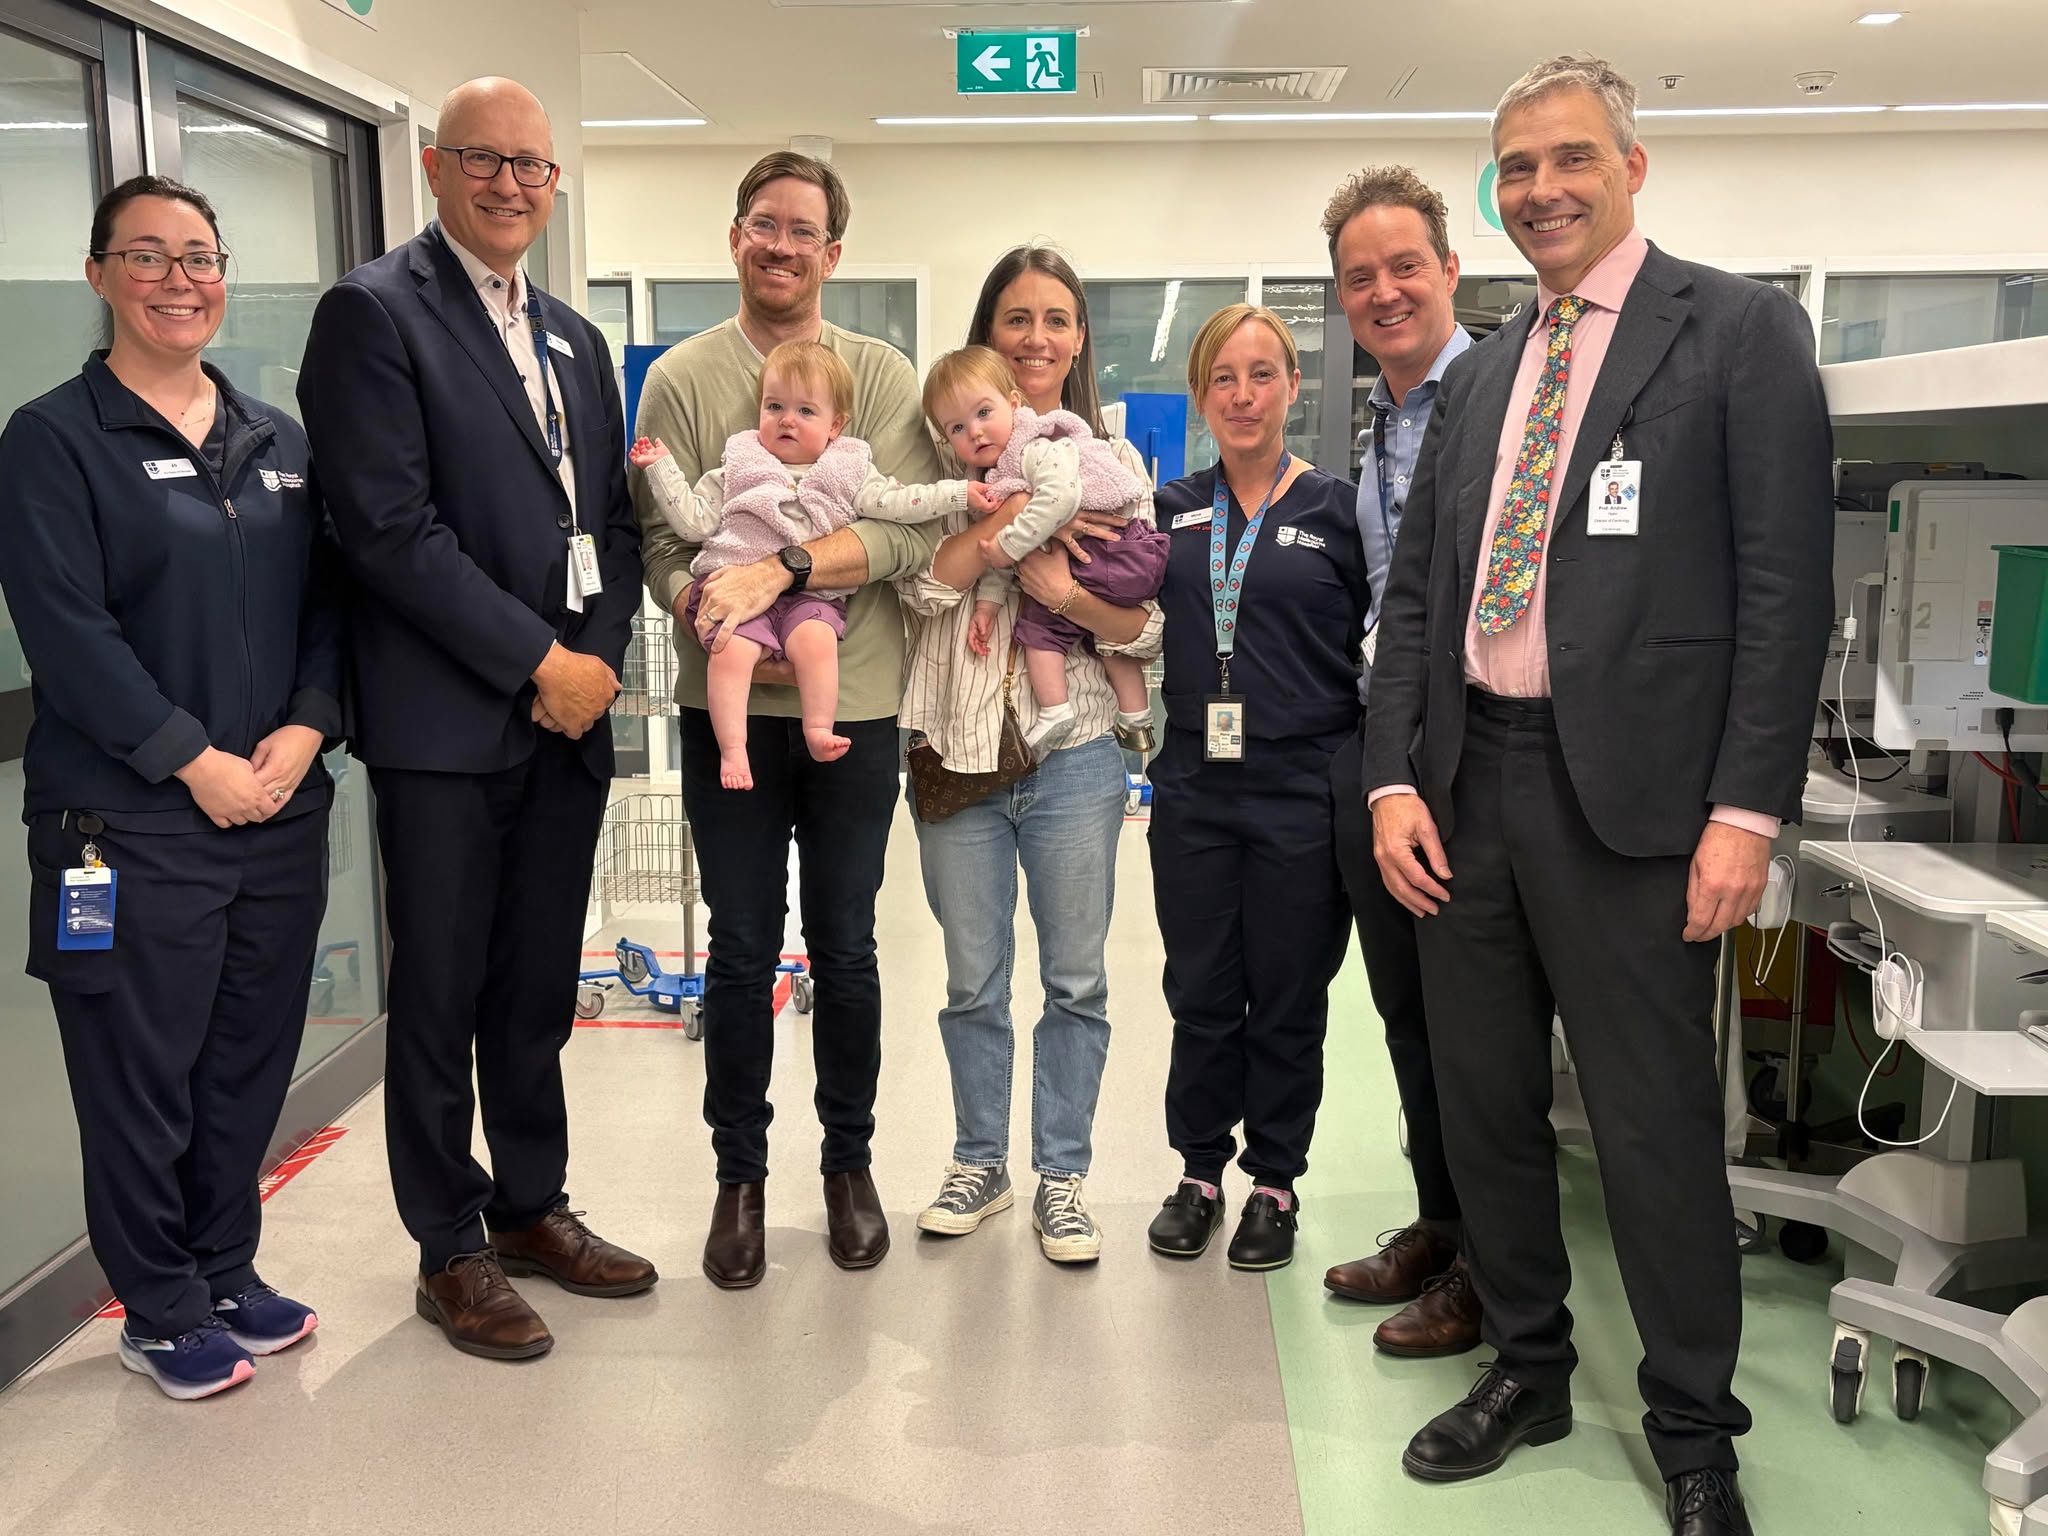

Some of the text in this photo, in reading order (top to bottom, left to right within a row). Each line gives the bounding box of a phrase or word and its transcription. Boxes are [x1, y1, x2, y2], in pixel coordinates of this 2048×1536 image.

[1298, 536, 1326, 547] Melbourne
[1309, 533, 1324, 542] Royal
[1914, 601, 1932, 630] 2
